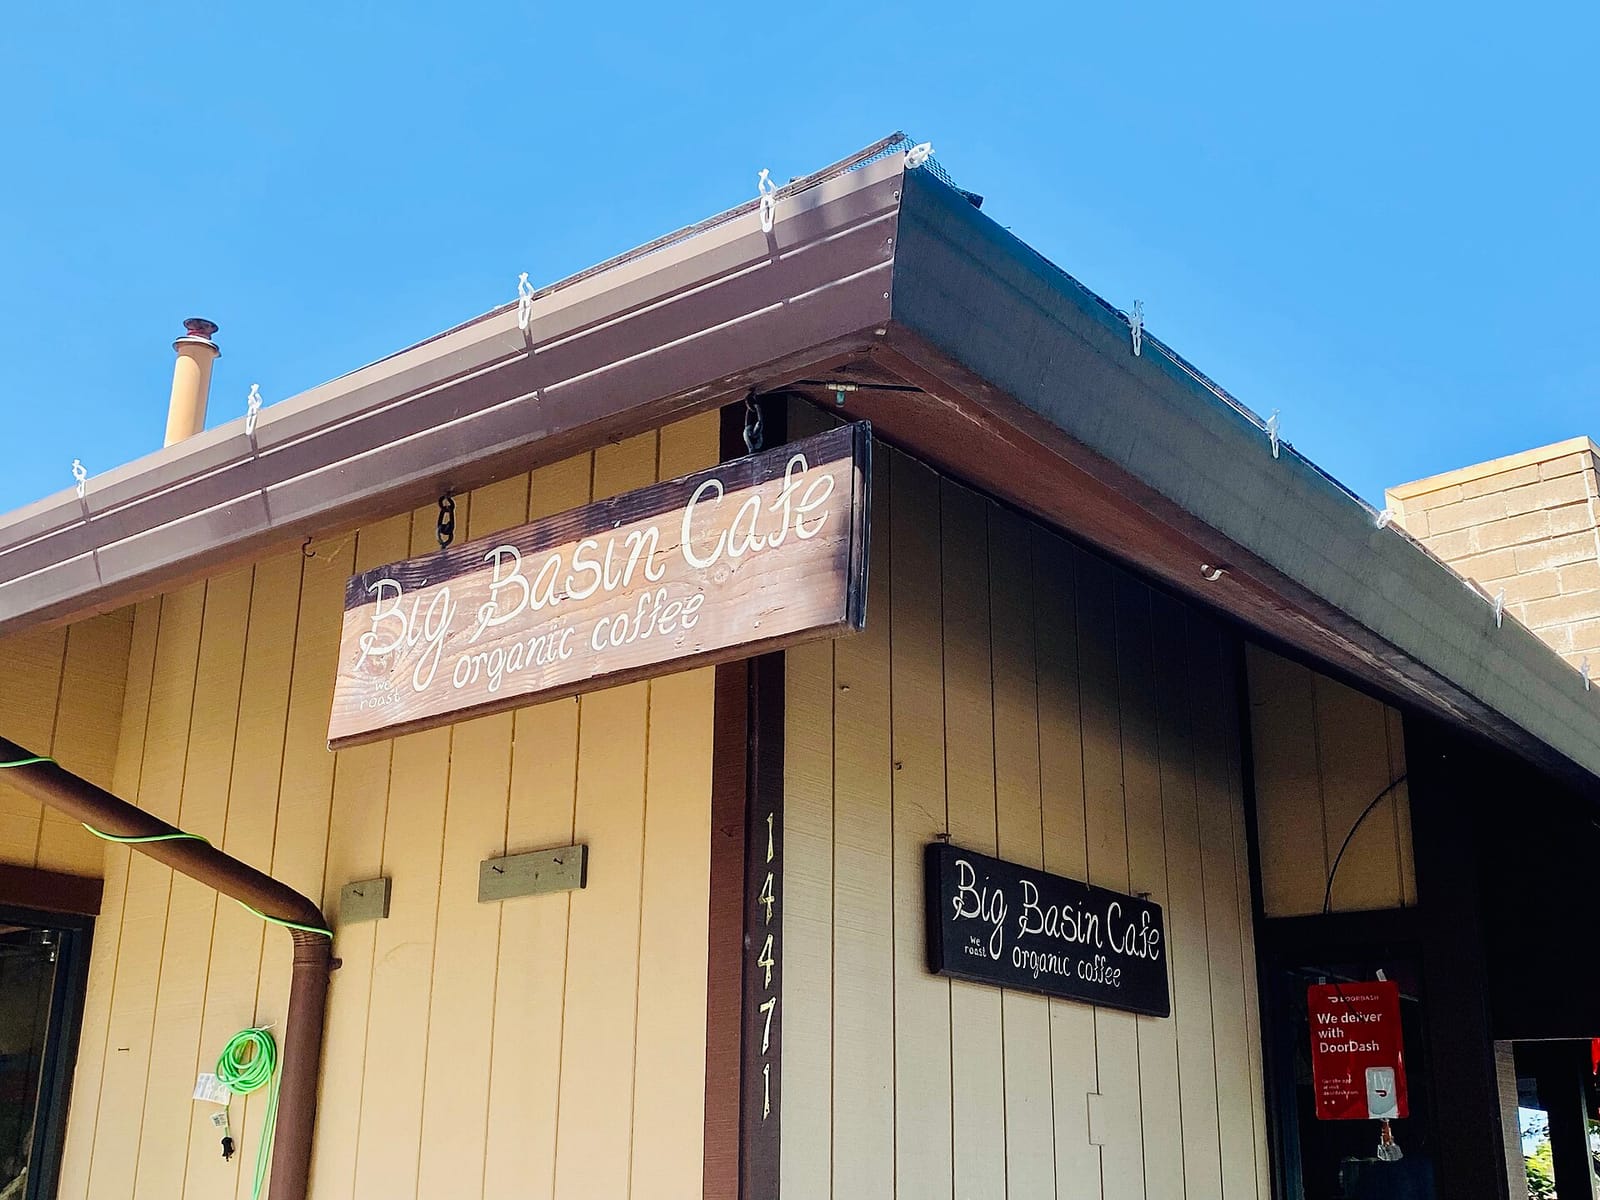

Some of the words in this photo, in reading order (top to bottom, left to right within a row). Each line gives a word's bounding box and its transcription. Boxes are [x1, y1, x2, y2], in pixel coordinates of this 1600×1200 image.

[352, 578, 458, 692] Big
[469, 525, 665, 643] Basin
[680, 453, 836, 569] Cafe
[452, 625, 575, 693] organic
[591, 588, 706, 652] coffee
[360, 687, 401, 711] roast
[952, 860, 1007, 960] Big
[1017, 880, 1103, 949] Basin
[1107, 902, 1160, 961] Cafe
[757, 812, 776, 1122] 14471
[964, 945, 987, 958] roast
[1012, 946, 1070, 979] organic
[1077, 954, 1121, 988] coffee
[1317, 1013, 1338, 1024] We
[1318, 1027, 1344, 1039] with
[1320, 1040, 1380, 1053] DoorDash
